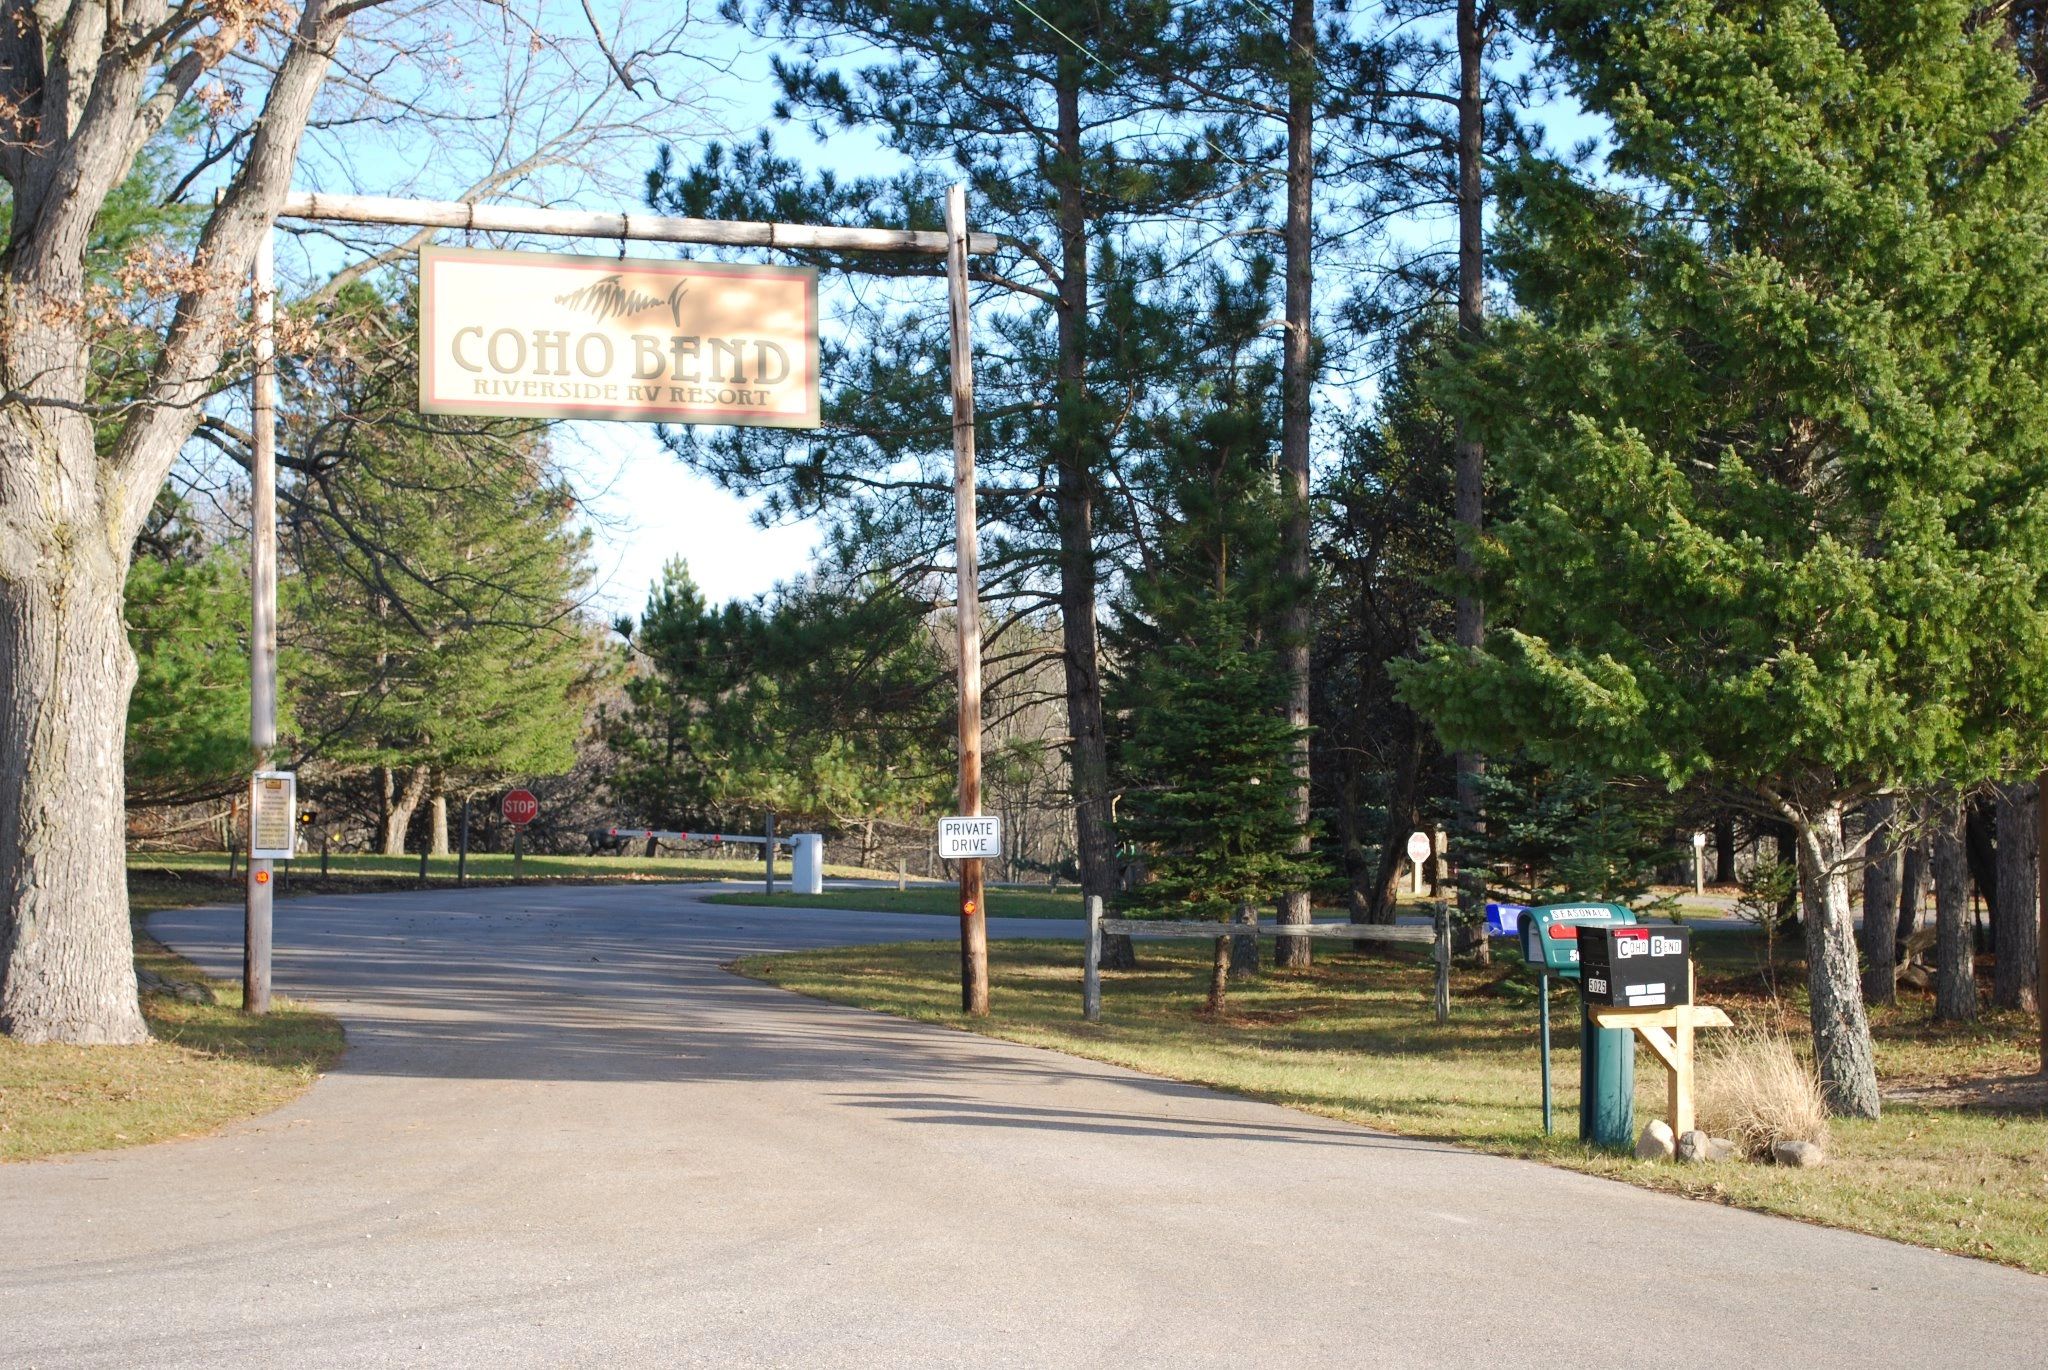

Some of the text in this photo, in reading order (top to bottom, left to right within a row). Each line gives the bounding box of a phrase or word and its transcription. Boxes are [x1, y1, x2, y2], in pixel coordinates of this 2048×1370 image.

[451, 325, 790, 385] COHO BEND
[473, 378, 770, 406] RIVERSIDE RV RESORT
[505, 800, 535, 813] STOP
[946, 822, 993, 836] PRIVATE
[952, 838, 987, 851] DRIVE
[1589, 979, 1606, 993] 5025
